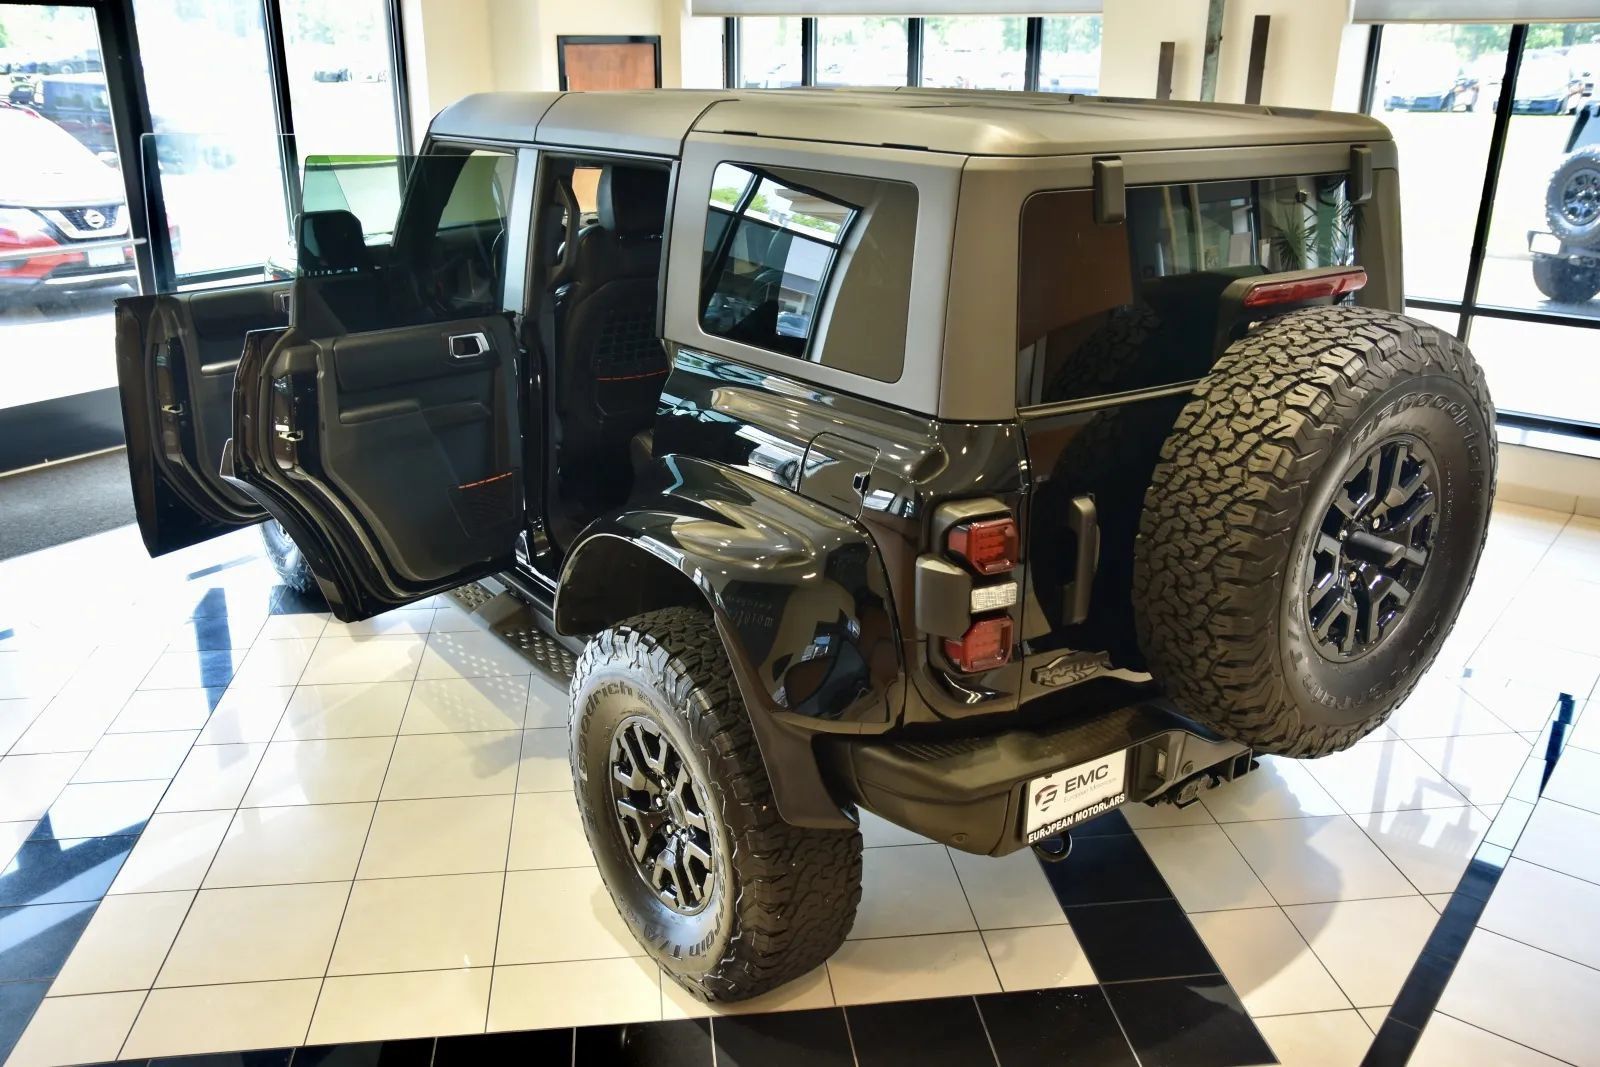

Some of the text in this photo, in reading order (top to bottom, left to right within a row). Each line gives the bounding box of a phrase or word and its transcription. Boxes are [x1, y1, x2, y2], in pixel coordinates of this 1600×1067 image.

[1064, 764, 1109, 793] EMC
[1028, 793, 1125, 844] EUROPEAN MOTORCARS
